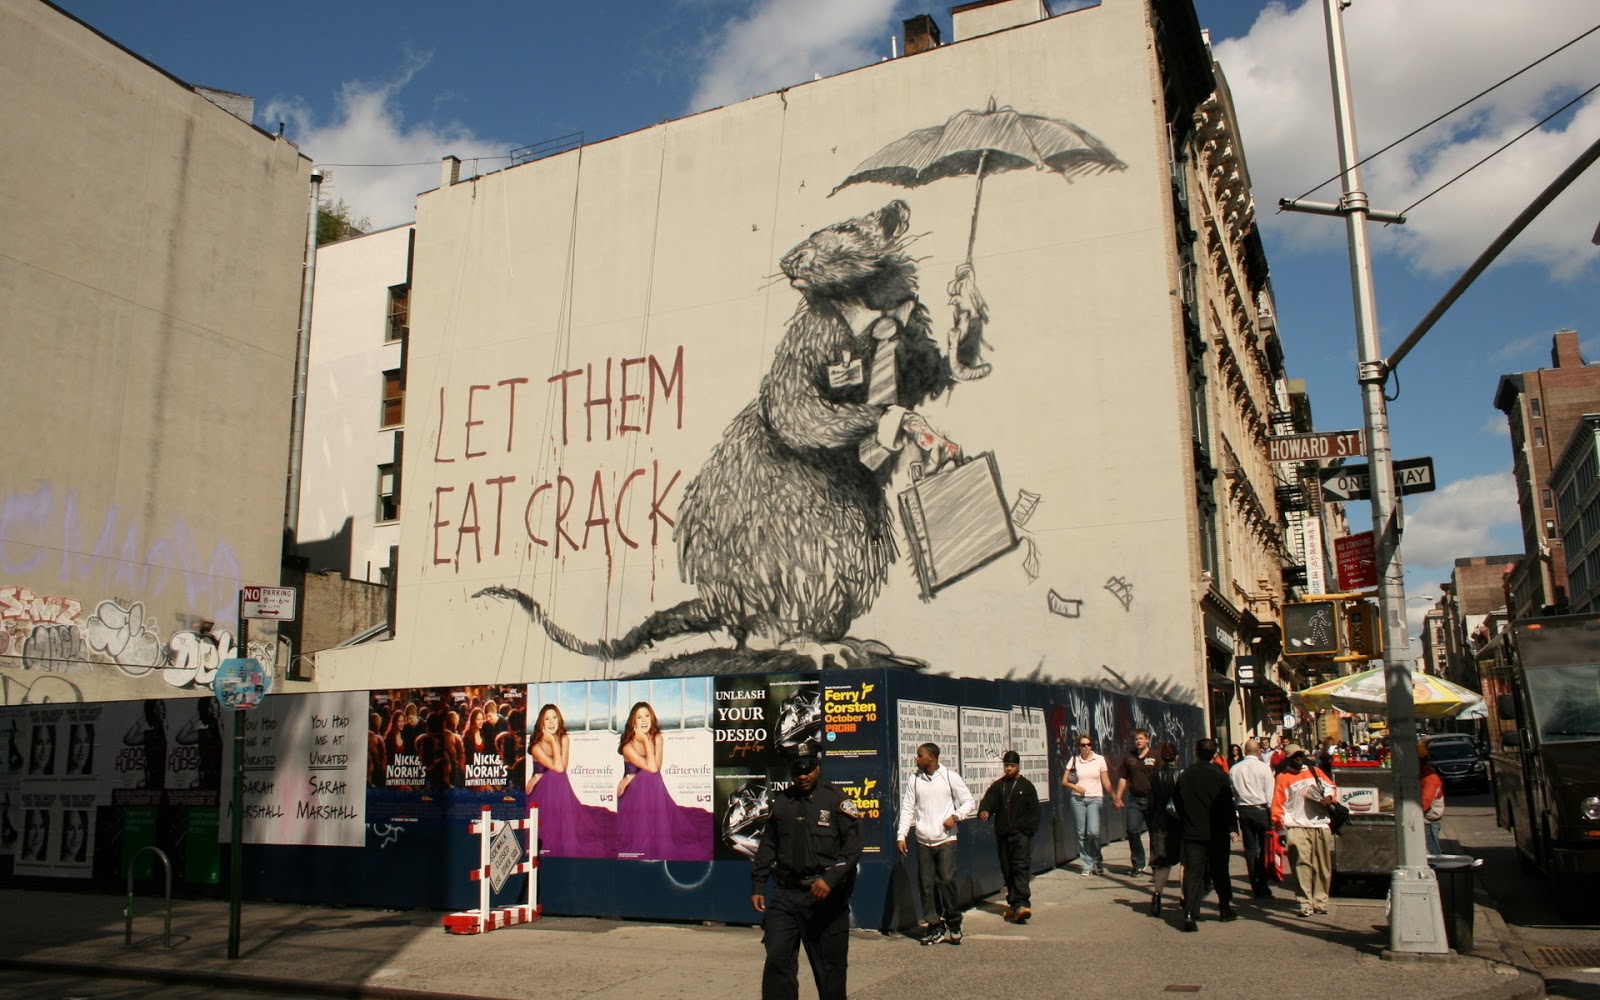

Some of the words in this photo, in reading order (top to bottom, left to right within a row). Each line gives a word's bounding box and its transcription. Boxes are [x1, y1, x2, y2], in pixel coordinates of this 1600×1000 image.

[434, 378, 529, 463] LET
[548, 345, 683, 445] THEM
[1270, 437, 1329, 460] HOWARD
[1337, 434, 1356, 456] ST
[1338, 475, 1369, 491] ONE
[1393, 468, 1426, 485] WAY
[434, 476, 516, 566] EAT
[525, 459, 681, 560] CRACK
[1338, 543, 1345, 551] NO
[1346, 538, 1371, 549] STANDING
[245, 588, 260, 601] NO
[263, 589, 292, 597] PARKING
[1352, 624, 1363, 648] BOOKS
[715, 690, 766, 701] UNLEASH
[825, 690, 859, 702] Ferry
[718, 707, 764, 721] YOUR
[825, 702, 876, 713] Corsten
[261, 717, 278, 730] HAD
[311, 715, 328, 729] YOU
[332, 715, 350, 728] HAD
[825, 714, 863, 723] October
[865, 713, 877, 722] 10
[315, 735, 328, 746] ME
[332, 734, 345, 746] AT
[715, 728, 767, 742] DESEO
[246, 738, 258, 747] ME
[262, 737, 273, 747] AT
[309, 751, 348, 766] UNRATED
[386, 764, 427, 778] NORAH'S
[465, 764, 508, 778] NORAH'S
[308, 775, 347, 796] SARAH
[385, 778, 405, 786] INFINITE
[406, 778, 426, 786] PLAYLIST
[465, 778, 486, 786] INFINITE
[486, 778, 507, 786] PLAYLIST
[842, 786, 861, 797] rry
[1342, 790, 1372, 802] SABRETT
[296, 800, 358, 819] MARSHALL
[852, 798, 879, 809] sten
[868, 810, 879, 818] 10
[494, 845, 510, 869] CLOSED
[494, 874, 502, 887] USE
[501, 859, 512, 875] OTHER
[510, 847, 519, 861] SIDE
